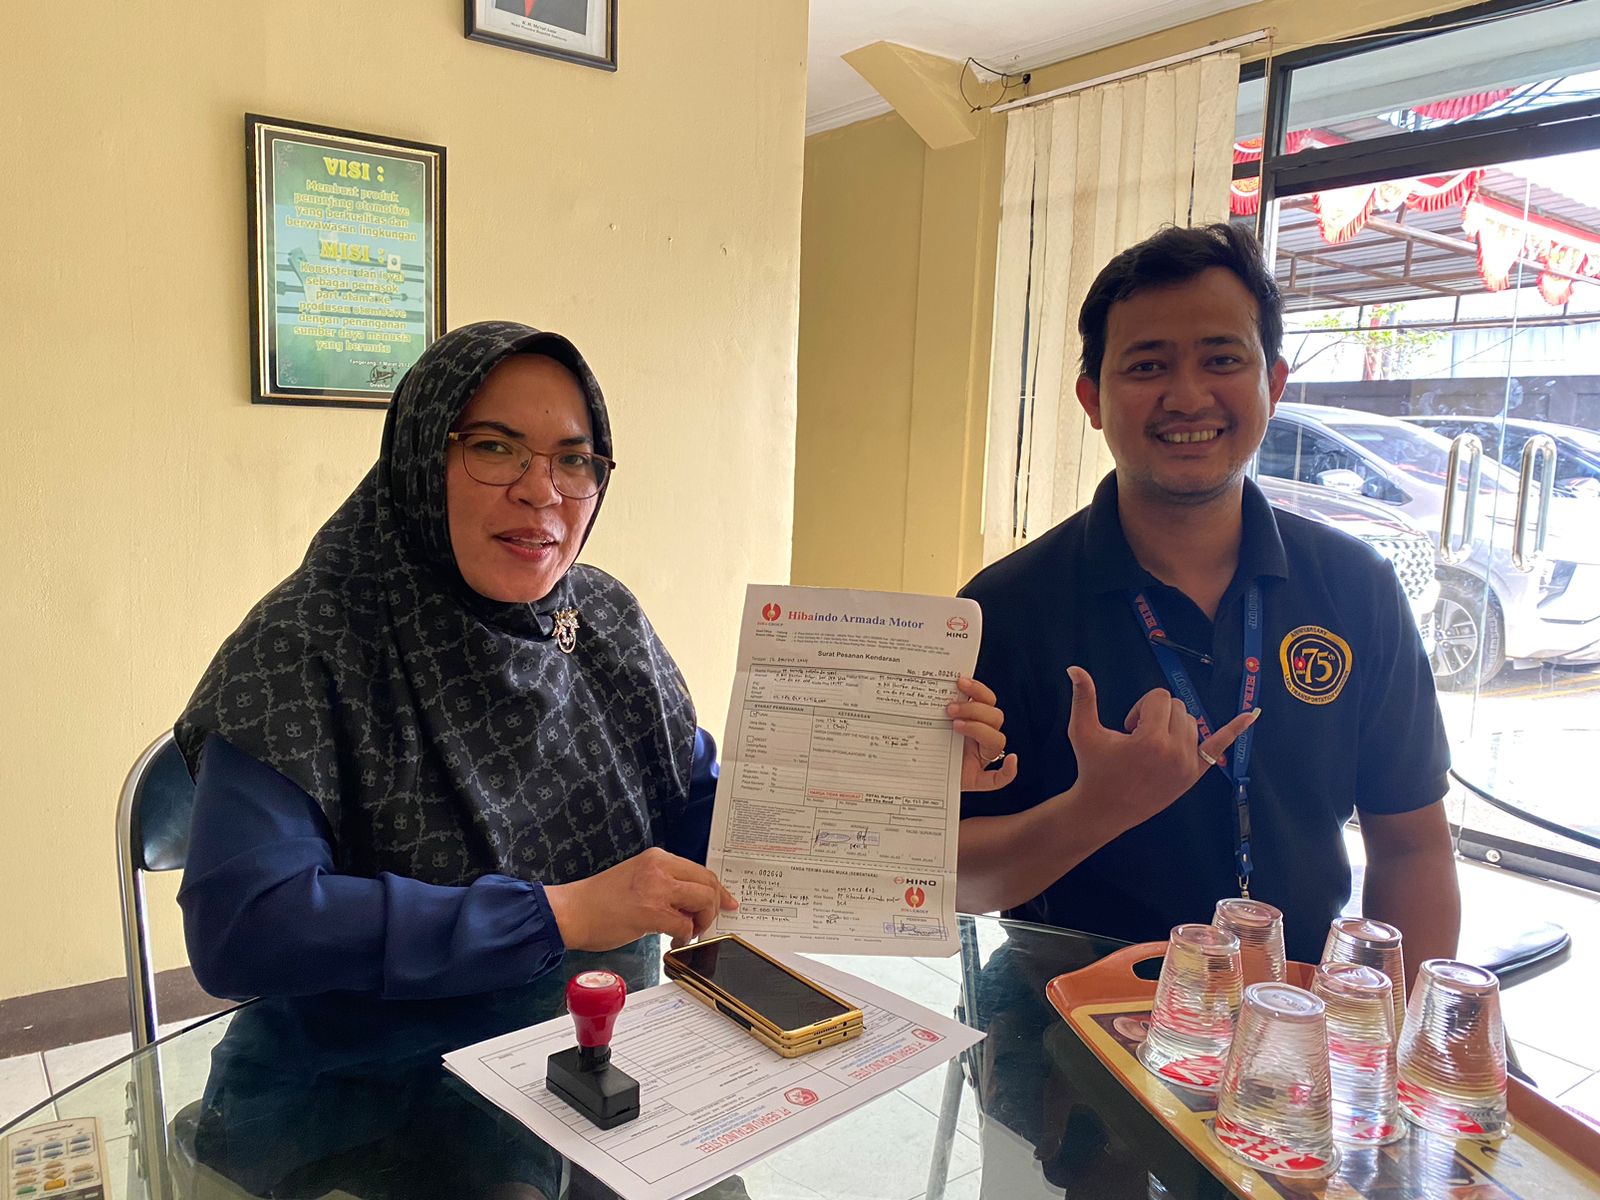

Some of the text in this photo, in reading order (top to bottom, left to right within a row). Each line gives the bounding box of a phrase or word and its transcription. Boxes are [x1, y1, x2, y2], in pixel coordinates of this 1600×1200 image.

[323, 156, 370, 181] VISI
[306, 179, 399, 203] Membuat produk
[294, 192, 410, 217] penunjang otomotive
[295, 206, 408, 228] yang berkualitas dan
[286, 216, 417, 242] berwawasan lingkungan
[319, 240, 371, 263] MISI
[301, 263, 405, 283] Konsisten dan loyal
[306, 276, 398, 295] sebagai pemasok
[316, 290, 391, 304] part utama ke
[299, 302, 407, 319] produsen otomotive
[298, 313, 406, 331] dengan penanganan
[294, 325, 411, 344] sumber daya manusia
[315, 339, 391, 354] yang bermutu
[788, 610, 924, 629] Hibaindo Armada Motor
[946, 631, 968, 639] HINO
[836, 651, 864, 659] Pesanan
[865, 654, 900, 663] Kendaraan
[1242, 674, 1256, 711] HIBA
[906, 878, 937, 887] HINO
